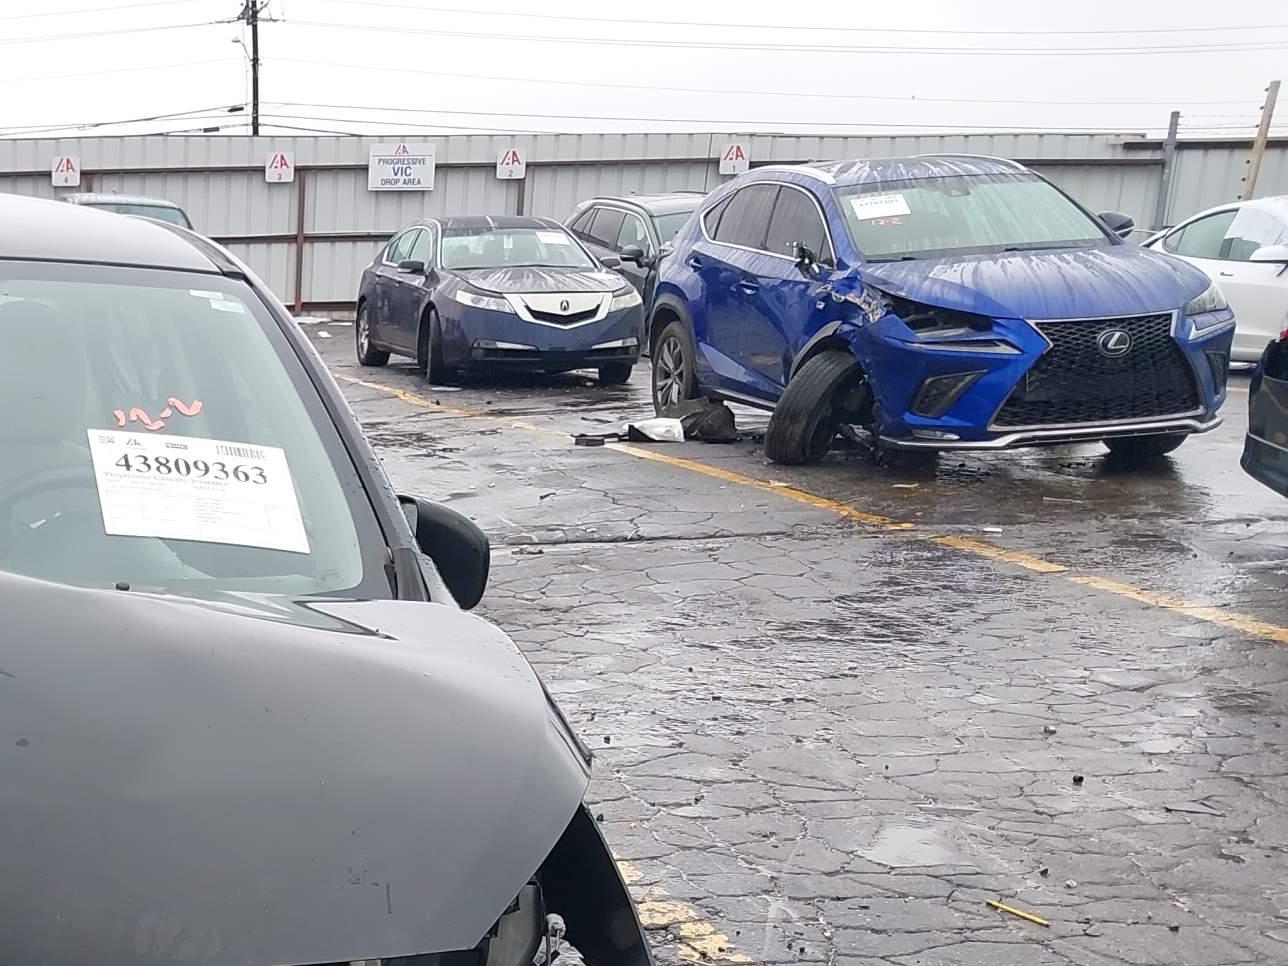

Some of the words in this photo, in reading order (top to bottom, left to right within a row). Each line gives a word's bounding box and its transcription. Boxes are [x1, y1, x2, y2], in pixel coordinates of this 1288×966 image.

[377, 157, 428, 166] PROGRESSIVE
[392, 166, 412, 177] VIC
[380, 178, 400, 186] DROP
[402, 178, 422, 186] AREA
[115, 453, 268, 485] 43809363
